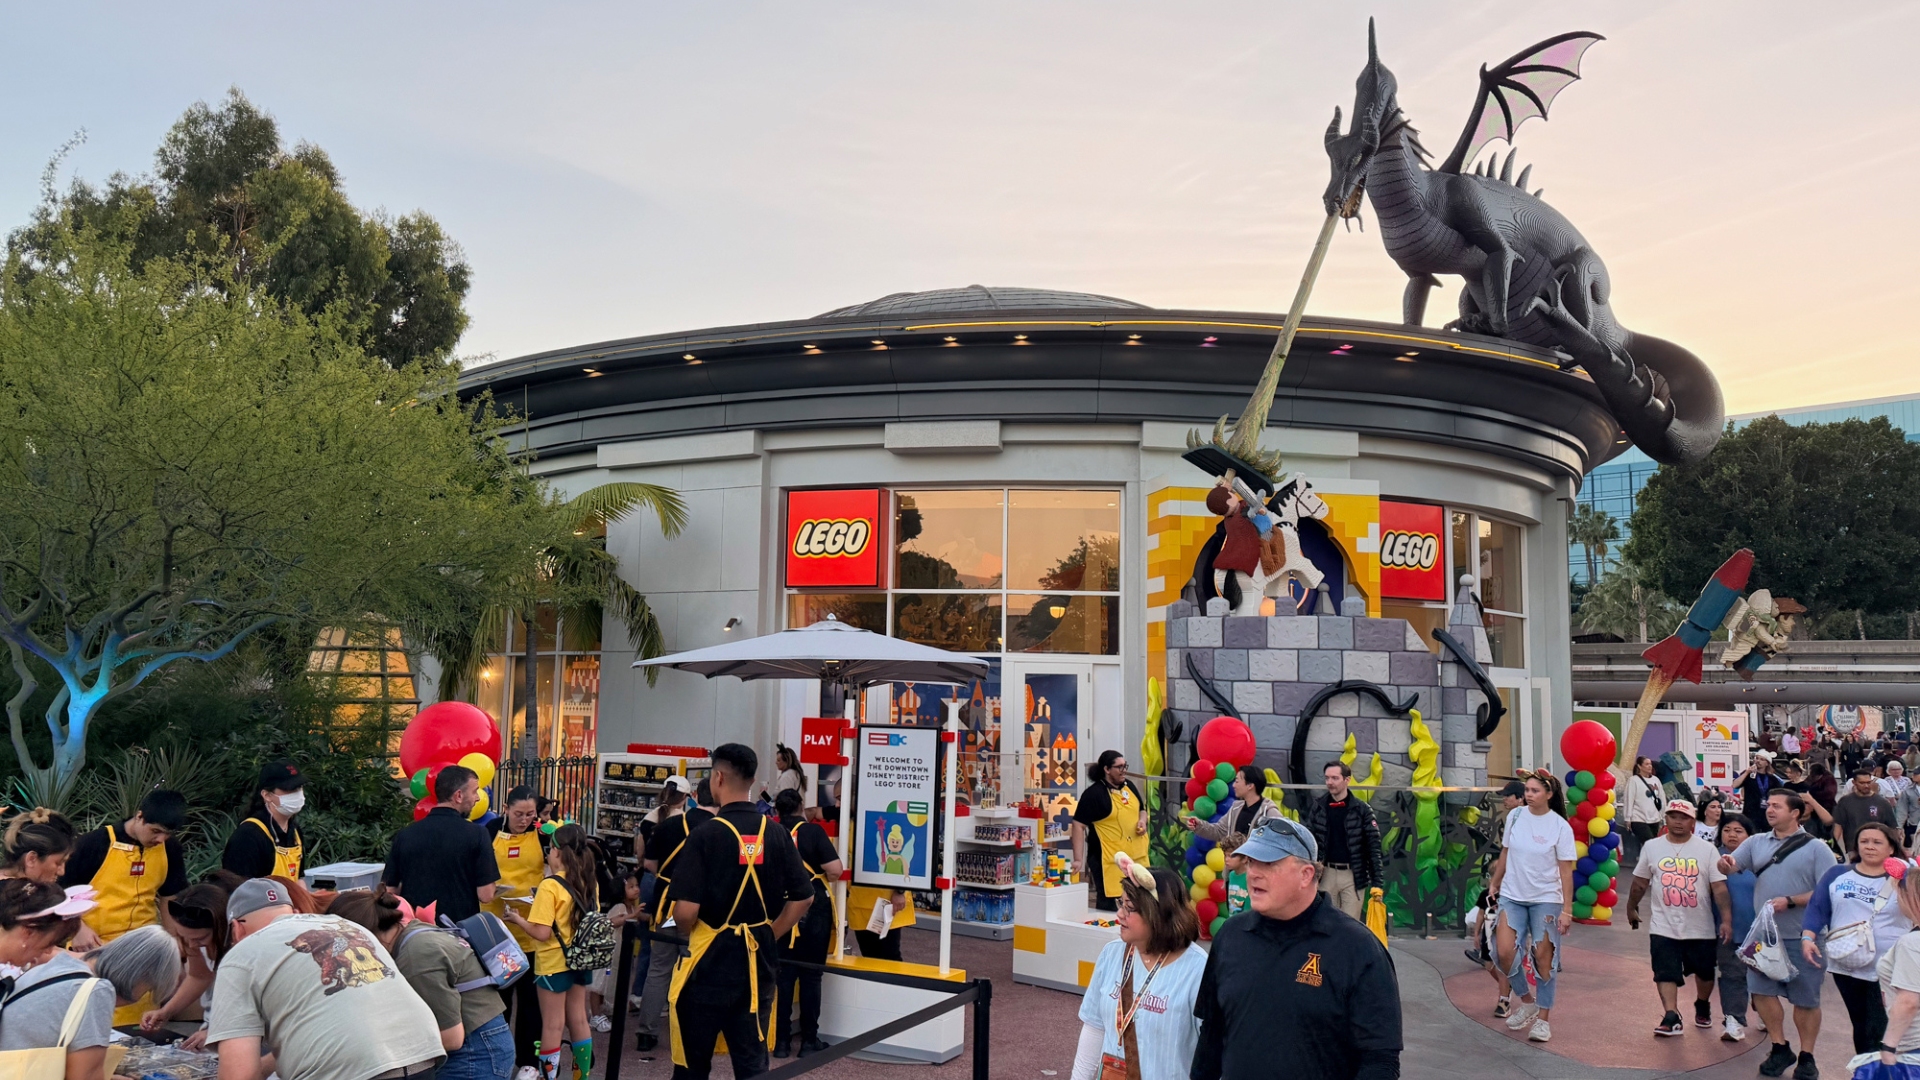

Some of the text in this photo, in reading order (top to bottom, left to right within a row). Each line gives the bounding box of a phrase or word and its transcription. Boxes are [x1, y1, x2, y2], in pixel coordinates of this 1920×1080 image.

[793, 518, 872, 559] LEGO
[1380, 529, 1440, 572] LEGO
[804, 734, 833, 746] PLAY
[875, 756, 910, 764] WELCOME
[884, 765, 929, 773] DOWNTOWN
[1711, 766, 1725, 774] LEGO
[266, 889, 278, 902] S
[1298, 952, 1322, 978] A
